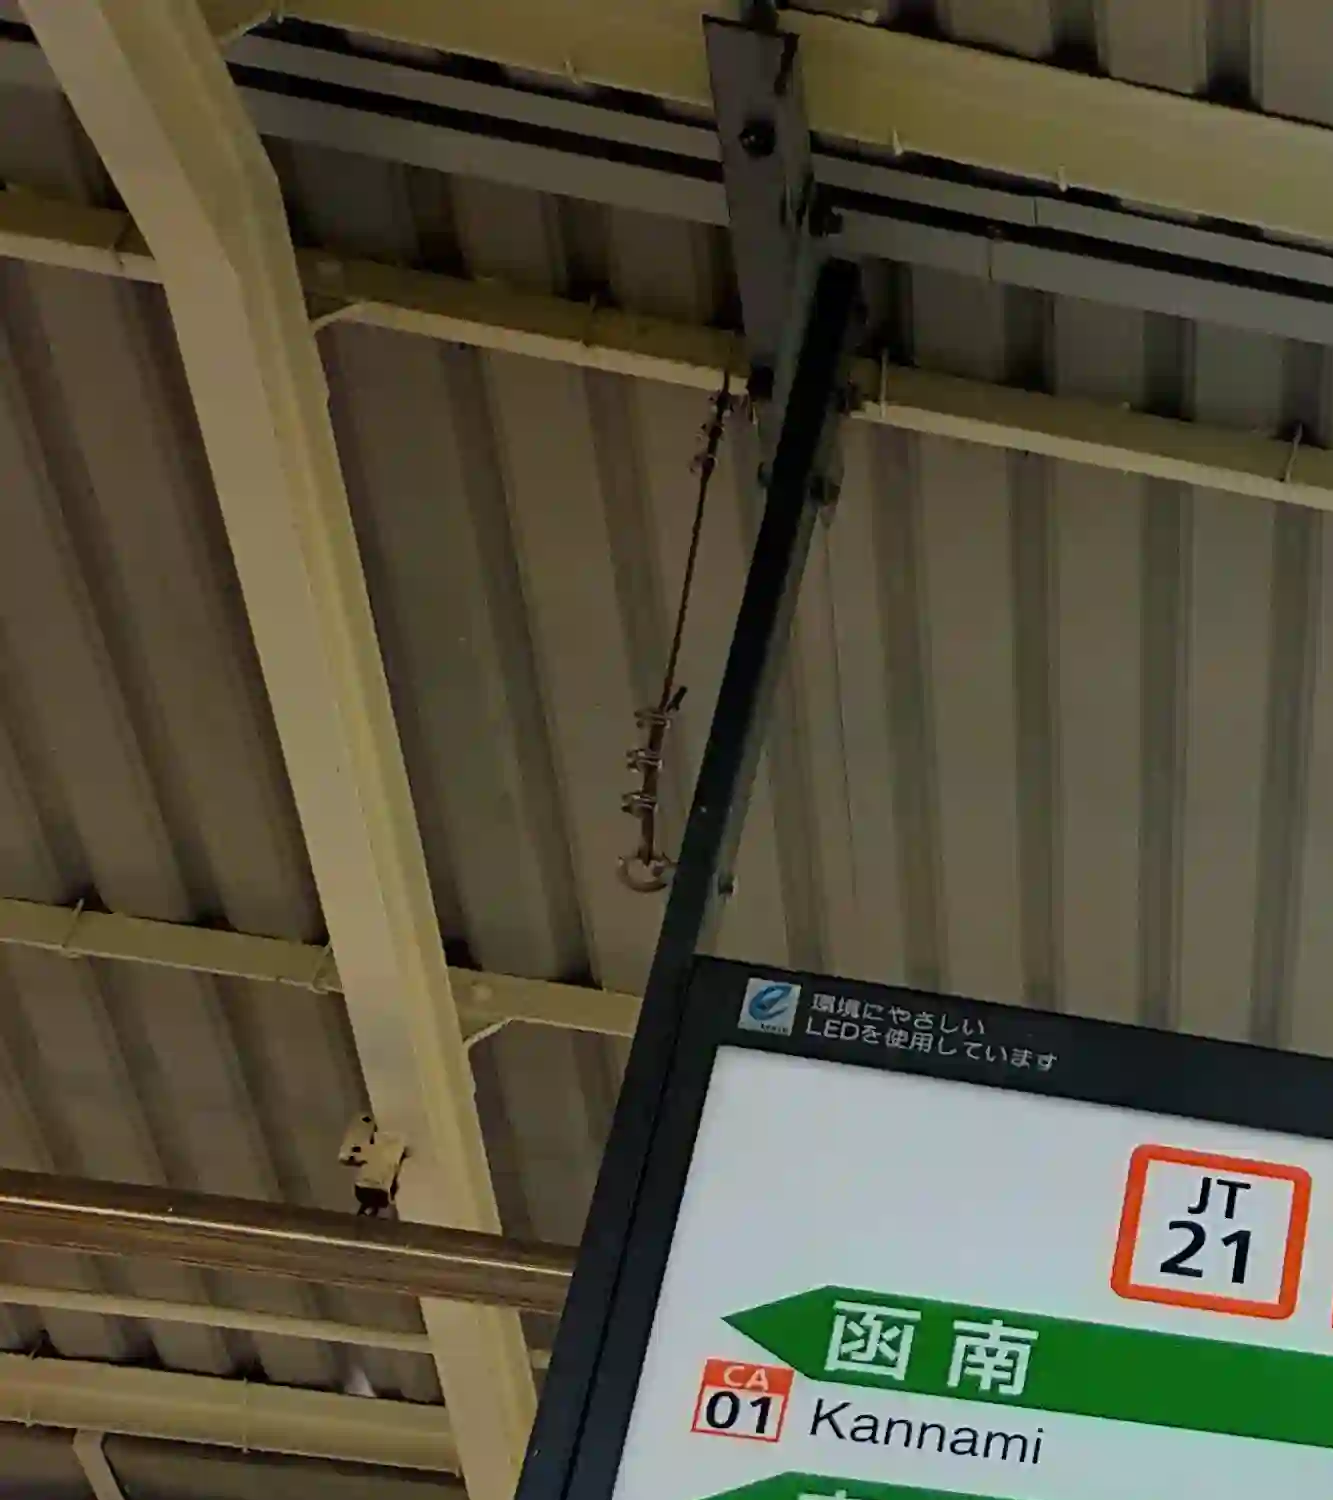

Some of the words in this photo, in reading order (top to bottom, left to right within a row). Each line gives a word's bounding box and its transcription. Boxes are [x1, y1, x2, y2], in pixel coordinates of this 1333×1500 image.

[811, 993, 985, 1036] 環境にやさしい
[806, 1017, 1058, 1072] LEDを使用しています
[1188, 1177, 1251, 1219] JT
[1160, 1221, 1250, 1284] 21
[824, 1301, 1038, 1396] 函南
[724, 1365, 769, 1391] CA
[706, 1391, 772, 1434] 01
[810, 1399, 1044, 1465] Kannami
